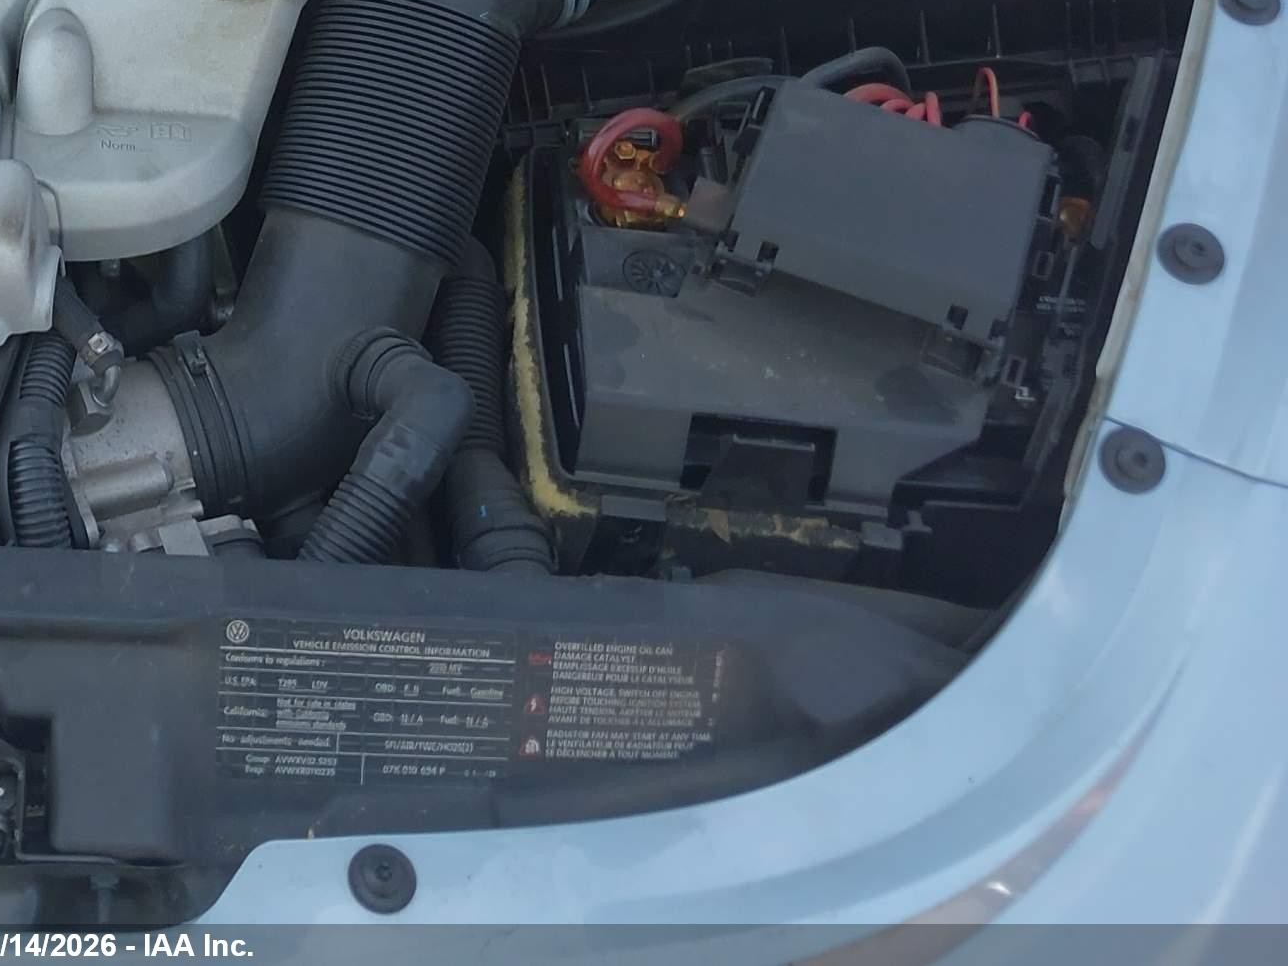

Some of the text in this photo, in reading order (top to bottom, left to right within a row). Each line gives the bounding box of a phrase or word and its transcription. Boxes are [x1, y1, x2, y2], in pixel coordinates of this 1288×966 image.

[343, 628, 425, 643] VOLKSWAGEN
[293, 639, 490, 658] VEHICLE EMISSION CONTROL INFORMATION
[555, 642, 673, 656] OVERFILLED ENGINE OIL CAN
[225, 652, 263, 663] Conforms
[265, 654, 273, 664] to
[554, 651, 592, 661] DAMAGE
[553, 671, 603, 681] DANGEREUX
[605, 674, 629, 682] POUR
[551, 686, 573, 695] HIGH
[618, 689, 650, 697] SWITCH
[652, 690, 665, 698] OFF
[550, 695, 581, 704] BEFORE
[583, 697, 626, 706] TOUCHING
[549, 705, 577, 714] HAUTE
[548, 715, 577, 723] AVANT
[580, 716, 590, 724] DE
[222, 733, 235, 743] No
[240, 734, 292, 746] adjustments
[547, 730, 589, 738] RADIATOR
[591, 731, 608, 739] FAN
[633, 732, 656, 740] START
[658, 732, 668, 740] AT
[671, 732, 689, 740] ANY
[546, 739, 555, 747] LE
[558, 739, 612, 748] VENTILATEUR
[545, 748, 554, 757] SE
[618, 750, 638, 759] TOUT
